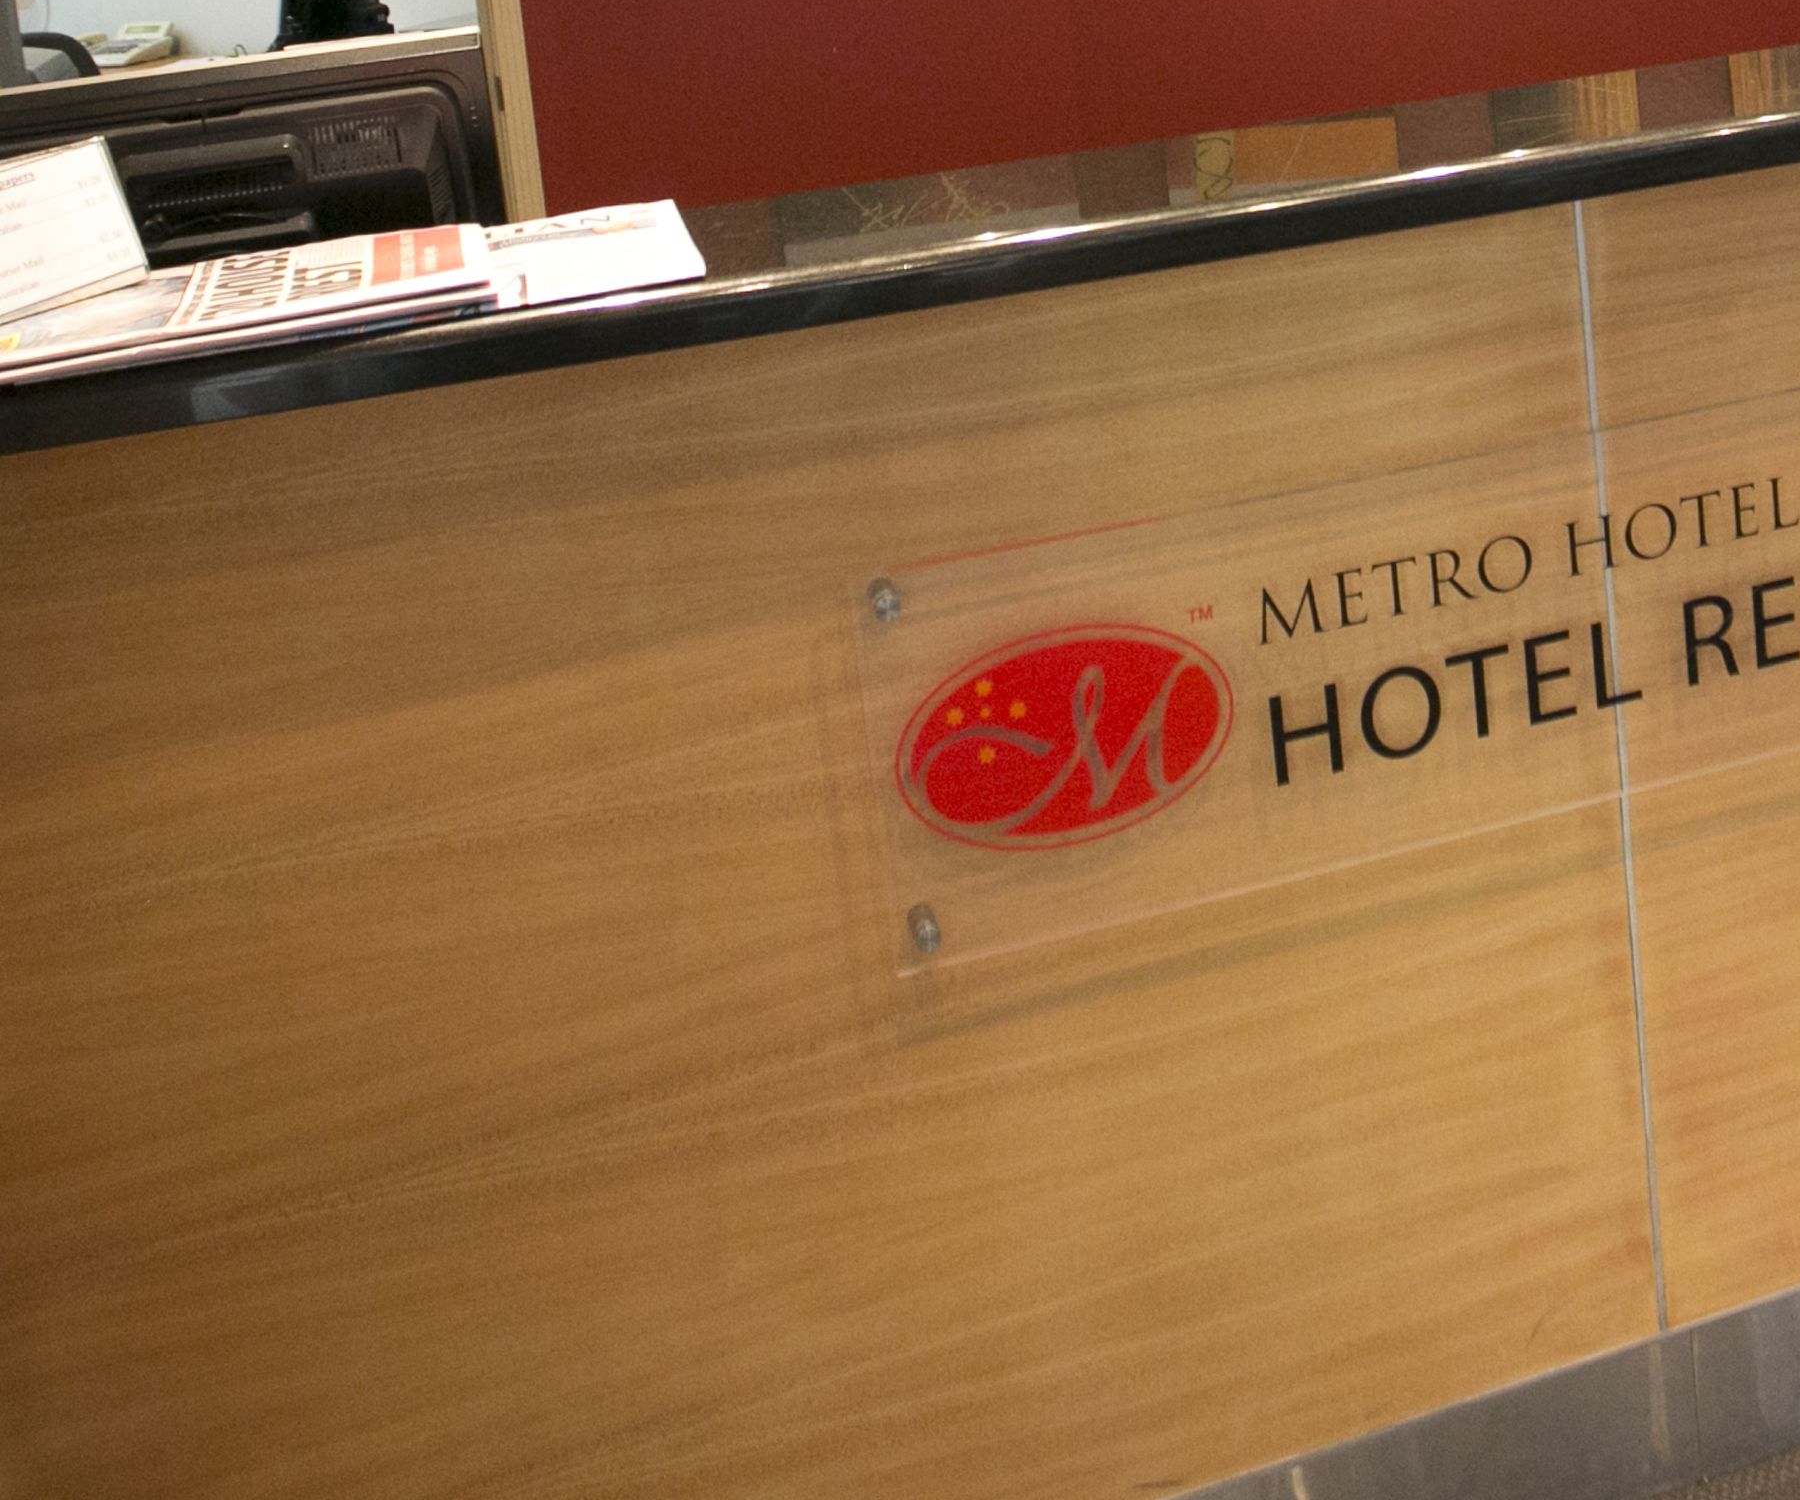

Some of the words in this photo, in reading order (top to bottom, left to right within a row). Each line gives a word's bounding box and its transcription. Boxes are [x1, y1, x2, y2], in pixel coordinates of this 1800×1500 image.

[1257, 536, 1536, 646] METRO
[1564, 476, 1800, 577] HOTEL
[1268, 622, 1643, 787] HOTEL
